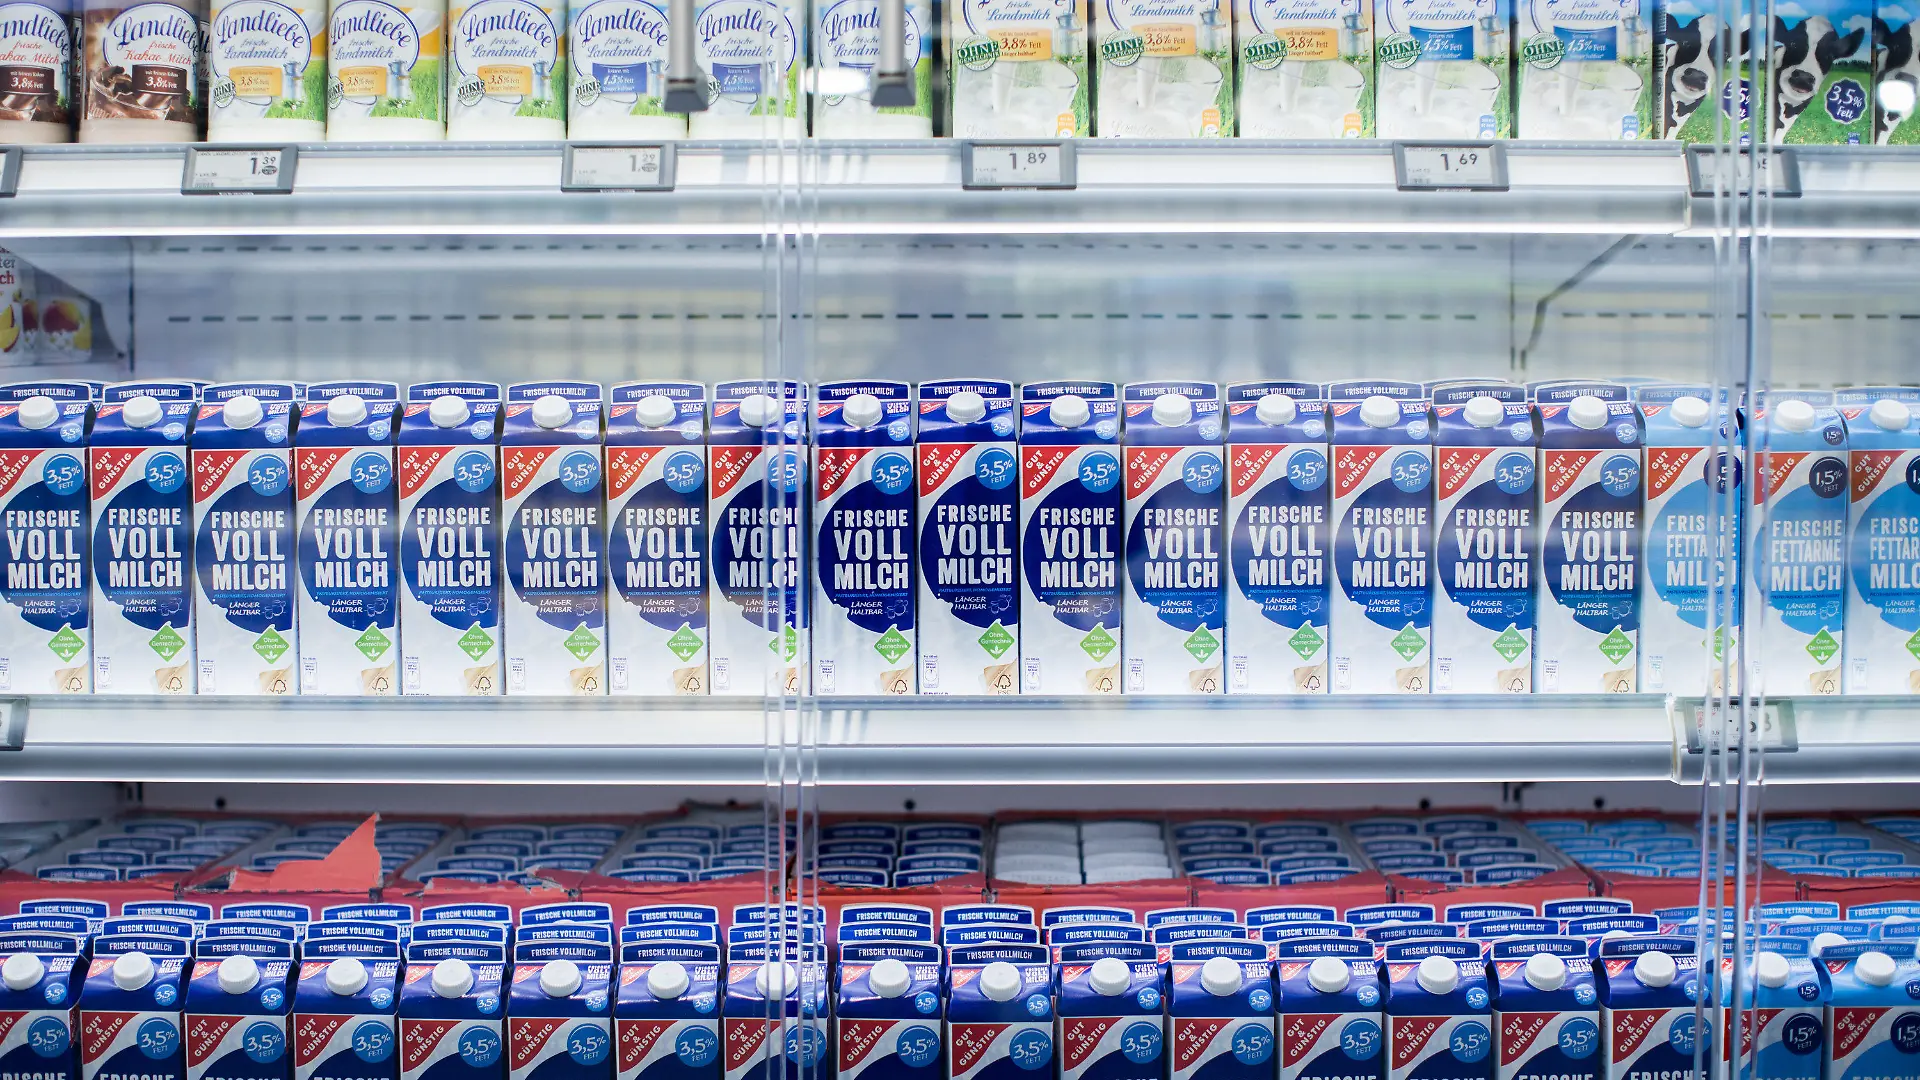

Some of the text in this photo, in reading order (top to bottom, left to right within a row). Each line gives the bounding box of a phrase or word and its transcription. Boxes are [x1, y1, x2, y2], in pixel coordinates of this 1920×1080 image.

[986, 8, 1051, 21] Landmilch
[1130, 5, 1195, 17] Landmilch
[1272, 8, 1337, 21] Landmilch
[1406, 10, 1477, 21] Landmilch
[1551, 9, 1620, 21] Landmilch
[217, 9, 305, 49] Landliebe
[331, 9, 411, 48] Landliebe
[462, 7, 552, 48] Landliebe
[579, 8, 669, 46] Landliebe
[999, 38, 1027, 50] 3,8%
[1102, 37, 1143, 53] OHNE
[1144, 33, 1171, 47] 3,8%
[1245, 41, 1286, 56] OHNE
[1287, 37, 1314, 49] 3,8%
[1380, 40, 1421, 56] OHNE
[1424, 38, 1449, 51] 1,5%
[1524, 40, 1565, 56] OHNE
[1566, 38, 1592, 52] 1,5%
[124, 50, 192, 65] Kakao Milch
[224, 47, 288, 60] Landmilch
[471, 47, 538, 59] Landmilch
[587, 45, 652, 58] Landmilch
[957, 42, 999, 57] OHNE
[145, 77, 167, 88] 3,8%
[1828, 86, 1863, 108] 3,5%
[1836, 107, 1853, 119] Fett
[1009, 152, 1047, 171] 1,89
[1440, 153, 1478, 172] 1,69
[119, 388, 180, 398] FRISCHE VOLLMILCH
[322, 387, 383, 396] FRISCHE VOLLMILCH
[1345, 387, 1408, 396] FRISCHE VOLLMILCH
[1551, 388, 1613, 399] FRISCHE VOLLMILCH
[197, 454, 214, 473] GUT
[922, 447, 940, 467] GUT
[934, 457, 942, 467] &
[1234, 448, 1251, 468] GUT
[1245, 459, 1253, 467] &
[148, 464, 182, 482] 3,5%
[201, 455, 235, 493] GÜNSTIG
[208, 464, 215, 473] &
[456, 463, 491, 481] 3,5%
[927, 448, 961, 487] GÜNSTIG
[1082, 464, 1116, 481] 3,5%
[1237, 449, 1273, 488] GÜNSTIG
[1395, 463, 1428, 481] 3,5%
[160, 480, 175, 489] FETT
[469, 478, 485, 487] FETT
[1094, 478, 1109, 487] FETT
[1406, 478, 1421, 487] FETT
[1815, 469, 1843, 487] 1,5%
[1823, 484, 1838, 493] FETT
[6, 510, 81, 528] FRISCHE
[108, 508, 182, 526] FRISCHE
[211, 511, 285, 528] FRISCHE
[314, 508, 388, 526] FRISCHE
[416, 507, 490, 526] FRISCHE
[522, 507, 597, 526] FRISCHE
[625, 507, 700, 526] FRISCHE
[833, 509, 908, 527] FRISCHE
[937, 504, 1012, 523] FRISCHE
[1040, 507, 1115, 526] FRISCHE
[1144, 508, 1218, 526] FRISCHE
[1248, 505, 1323, 524] FRISCHE
[1352, 507, 1427, 526] FRISCHE
[1455, 508, 1529, 527] FRISCHE
[1561, 511, 1635, 529] FRISCHE
[1772, 519, 1842, 537] FRISCHE
[7, 529, 81, 561] VOLL
[109, 527, 182, 559] VOLL
[212, 530, 285, 562] VOLL
[314, 527, 388, 559] VOLL
[417, 527, 491, 558] VOLL
[522, 526, 597, 558] VOLL
[626, 527, 700, 558] VOLL
[834, 529, 908, 561] VOLL
[938, 524, 1012, 556] VOLL
[1040, 527, 1115, 559] VOLL
[1144, 527, 1218, 559] VOLL
[1249, 525, 1323, 557] VOLL
[1352, 526, 1426, 558] VOLL
[1455, 528, 1528, 560] VOLL
[1562, 531, 1634, 562] VOLL
[1771, 539, 1841, 563] FETTARME
[7, 562, 82, 589] MILCH
[109, 560, 183, 588] MILCH
[212, 563, 286, 591] MILCH
[315, 561, 388, 588] MILCH
[418, 560, 491, 587] MILCH
[523, 560, 598, 587] MILCH
[626, 561, 701, 588] MILCH
[834, 562, 908, 590] MILCH
[938, 557, 1012, 585] MILCH
[1040, 561, 1115, 588] MILCH
[1144, 561, 1218, 589] MILCH
[1249, 558, 1323, 586] MILCH
[1352, 560, 1426, 588] MILCH
[1454, 562, 1528, 589] MILCH
[1561, 564, 1634, 592] MILCH
[1771, 565, 1842, 591] MILCH
[331, 598, 363, 606] LÄNGER
[1056, 606, 1089, 614] HALTBAR
[1057, 598, 1088, 606] LÄNGER
[1558, 905, 1621, 914] FRISCHE VOLLMILCH
[1785, 923, 1863, 934] FRISCHE FETTARME MILCH
[109, 942, 172, 952] FRISCHE VOLLMILCH
[319, 943, 383, 953] FRISCHE VOLLMILCH
[638, 948, 703, 958] FRISCHE VOLLMILCH
[967, 951, 1032, 960] FRISCHE VOLLMILCH
[1294, 944, 1358, 953] FRISCHE VOLLMILCH
[1617, 943, 1681, 952] FRISCHE VOLLMILCH
[247, 1033, 281, 1052] 3,5%
[405, 1024, 423, 1043] GUT
[417, 1035, 424, 1043] &
[1452, 1033, 1488, 1052] 3,5%
[1786, 1025, 1817, 1043] 1,5%
[409, 1026, 445, 1062] GÜNSTIG
[1014, 1041, 1048, 1060] 3,5%
[1465, 1048, 1480, 1057] FETT
